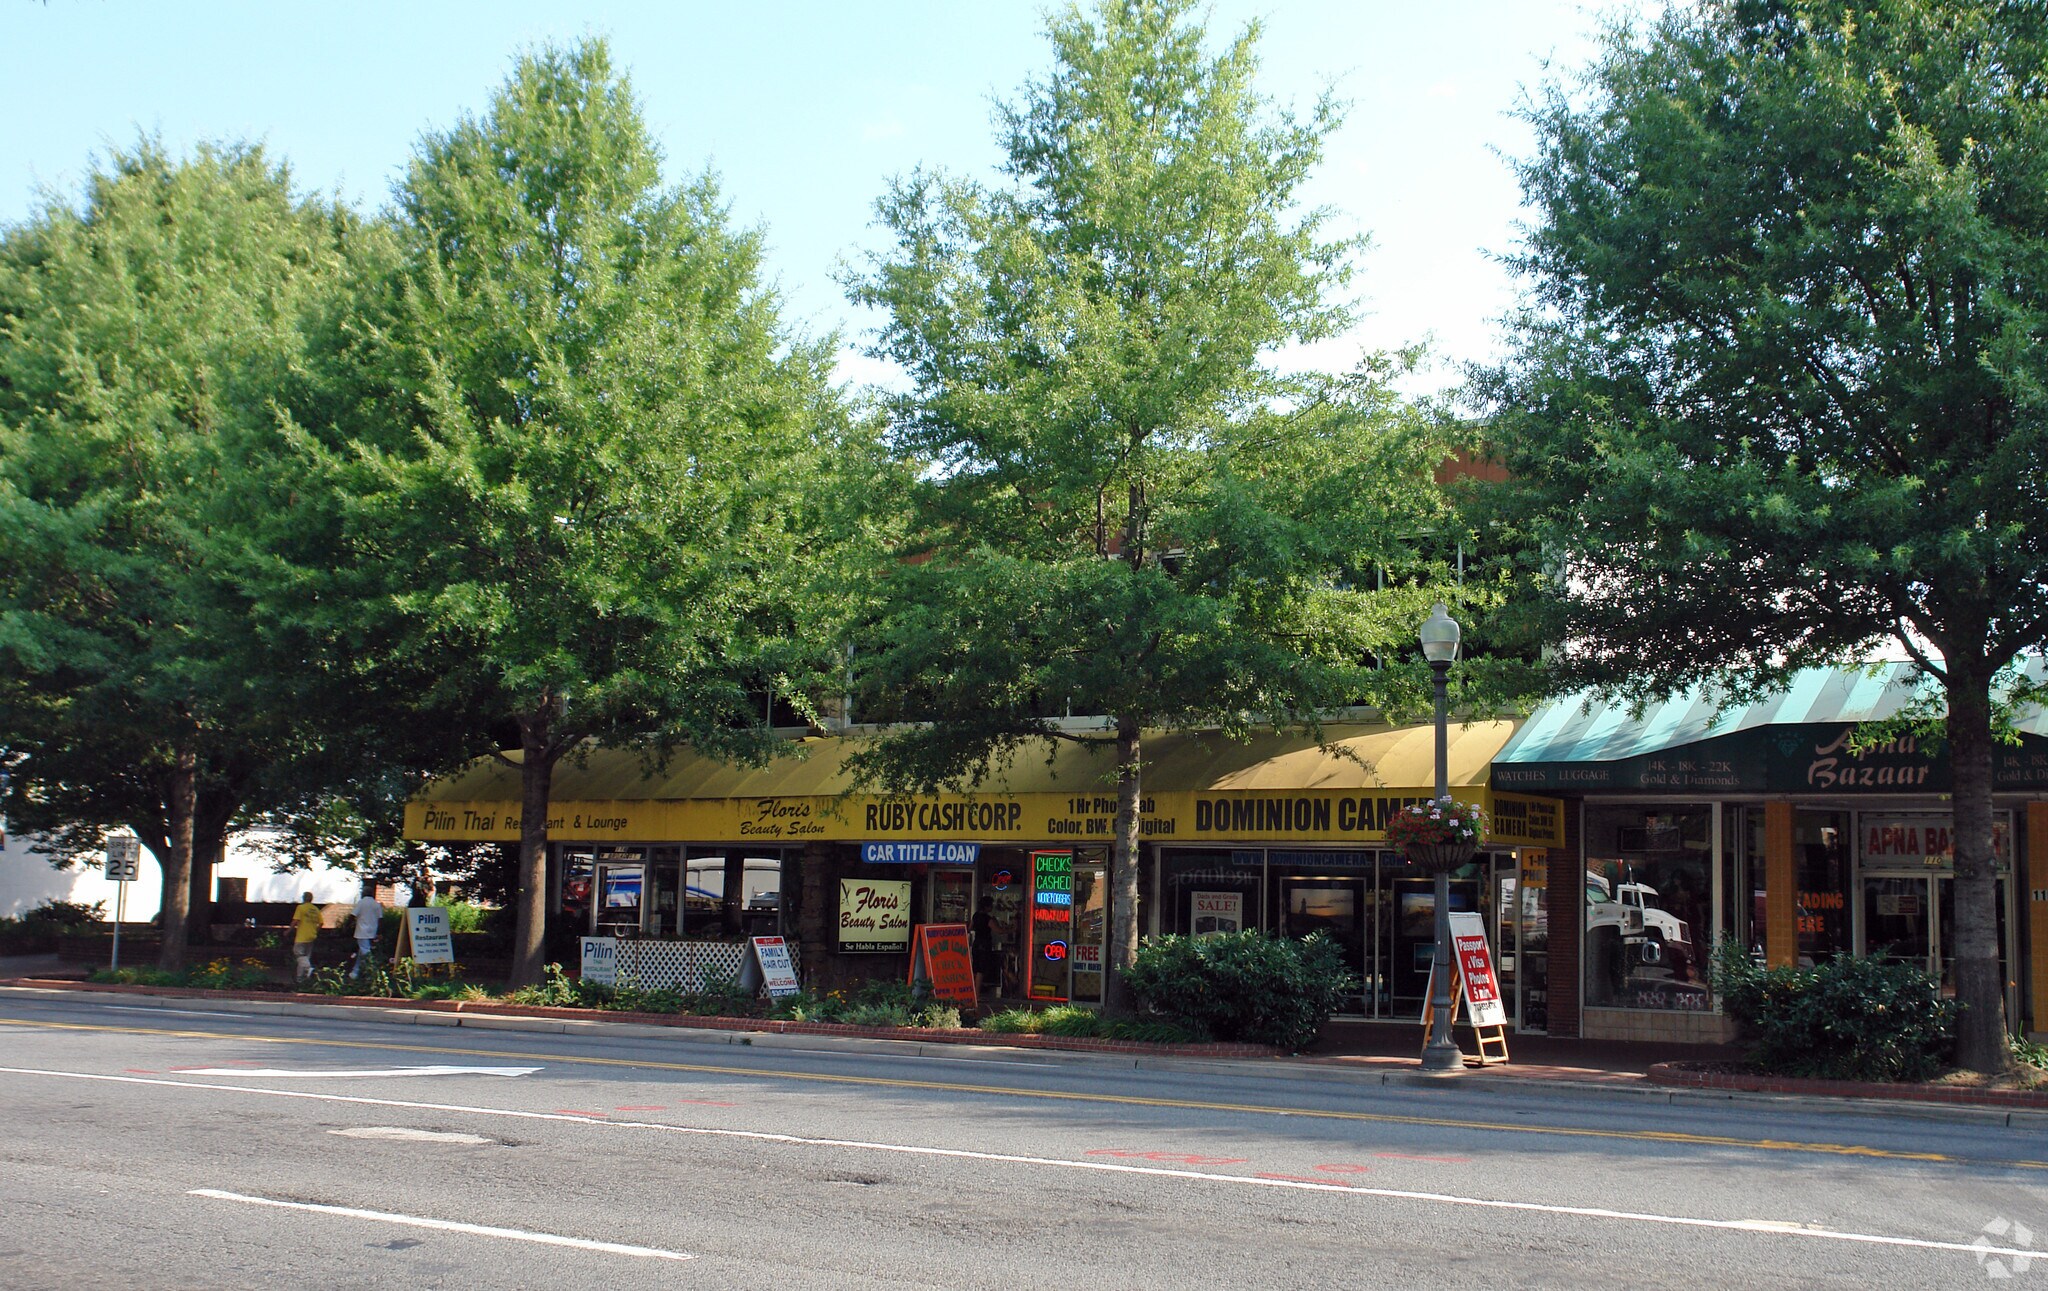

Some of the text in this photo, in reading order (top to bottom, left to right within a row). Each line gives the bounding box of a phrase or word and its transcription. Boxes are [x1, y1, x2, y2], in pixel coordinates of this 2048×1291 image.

[1708, 762, 1732, 772] 22K
[1808, 757, 1929, 788] Bazaar
[1498, 770, 1610, 782] WATCHES LUGGAGE
[1640, 774, 1666, 784] Gold
[1671, 775, 1680, 784] &
[757, 800, 811, 822] Floris
[866, 802, 1022, 831] RUBY CASH CORP.
[1196, 798, 1330, 832] DOMINION
[424, 811, 456, 831] Pilin
[463, 810, 496, 831] Thai
[573, 814, 582, 828] &
[587, 815, 628, 831] Lounge
[1138, 818, 1176, 836] igital
[1494, 818, 1527, 837] CAMERA
[740, 821, 825, 838] Beauty Salon
[110, 842, 137, 850] SPEED
[1868, 827, 1920, 856] APNA
[867, 843, 976, 862] CAR TITLE LOAN
[109, 860, 136, 876] 25
[1036, 856, 1072, 872] CHECKS
[1036, 874, 1072, 890] CASHED
[856, 887, 898, 913] Floris
[1198, 900, 1236, 911] SALE!
[418, 914, 440, 924] Pilin
[840, 912, 908, 932] Beauty Salon
[584, 942, 613, 958] Pilin
[761, 948, 784, 958] FAMILY
[1045, 944, 1066, 958] OPEN
[1076, 946, 1100, 961] FREE
[1458, 938, 1485, 954] Passport
[778, 959, 790, 968] CUT
[1470, 956, 1485, 968] Visa
[1468, 972, 1490, 986] Photos
[1473, 986, 1479, 1000] 5
